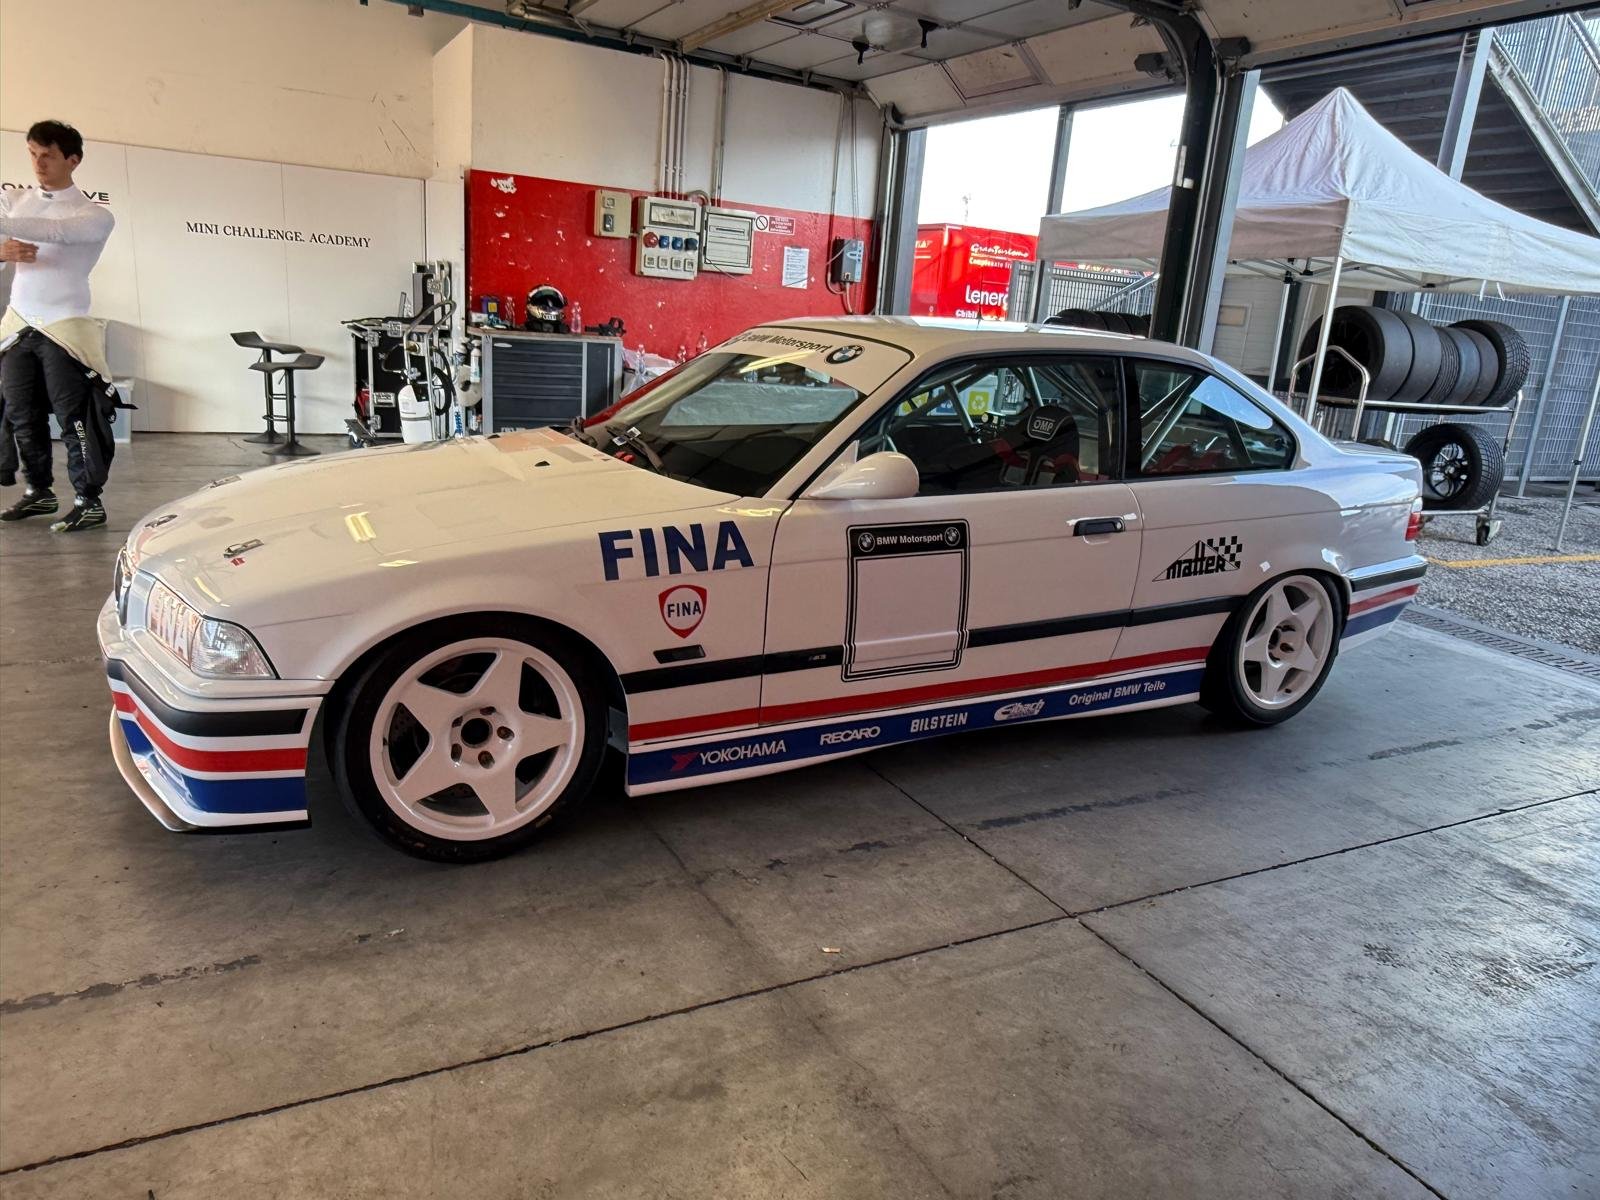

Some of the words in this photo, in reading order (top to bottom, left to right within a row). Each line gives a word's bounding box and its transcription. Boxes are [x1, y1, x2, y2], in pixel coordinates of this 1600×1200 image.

[186, 221, 219, 235] MINI
[309, 233, 371, 248] ACADEMY
[766, 335, 833, 353] Motorsport
[1033, 419, 1054, 431] OMP
[876, 535, 898, 545] BMW
[900, 533, 943, 544] Motorsport
[598, 520, 754, 581] FINA
[667, 600, 701, 618] FINA
[1069, 689, 1111, 706] Original
[1114, 683, 1141, 698] BMW
[1143, 680, 1166, 693] Teile
[910, 712, 968, 733] BILSTEIN
[820, 725, 881, 745] RECARO
[700, 740, 787, 766] YOKOHAMA
